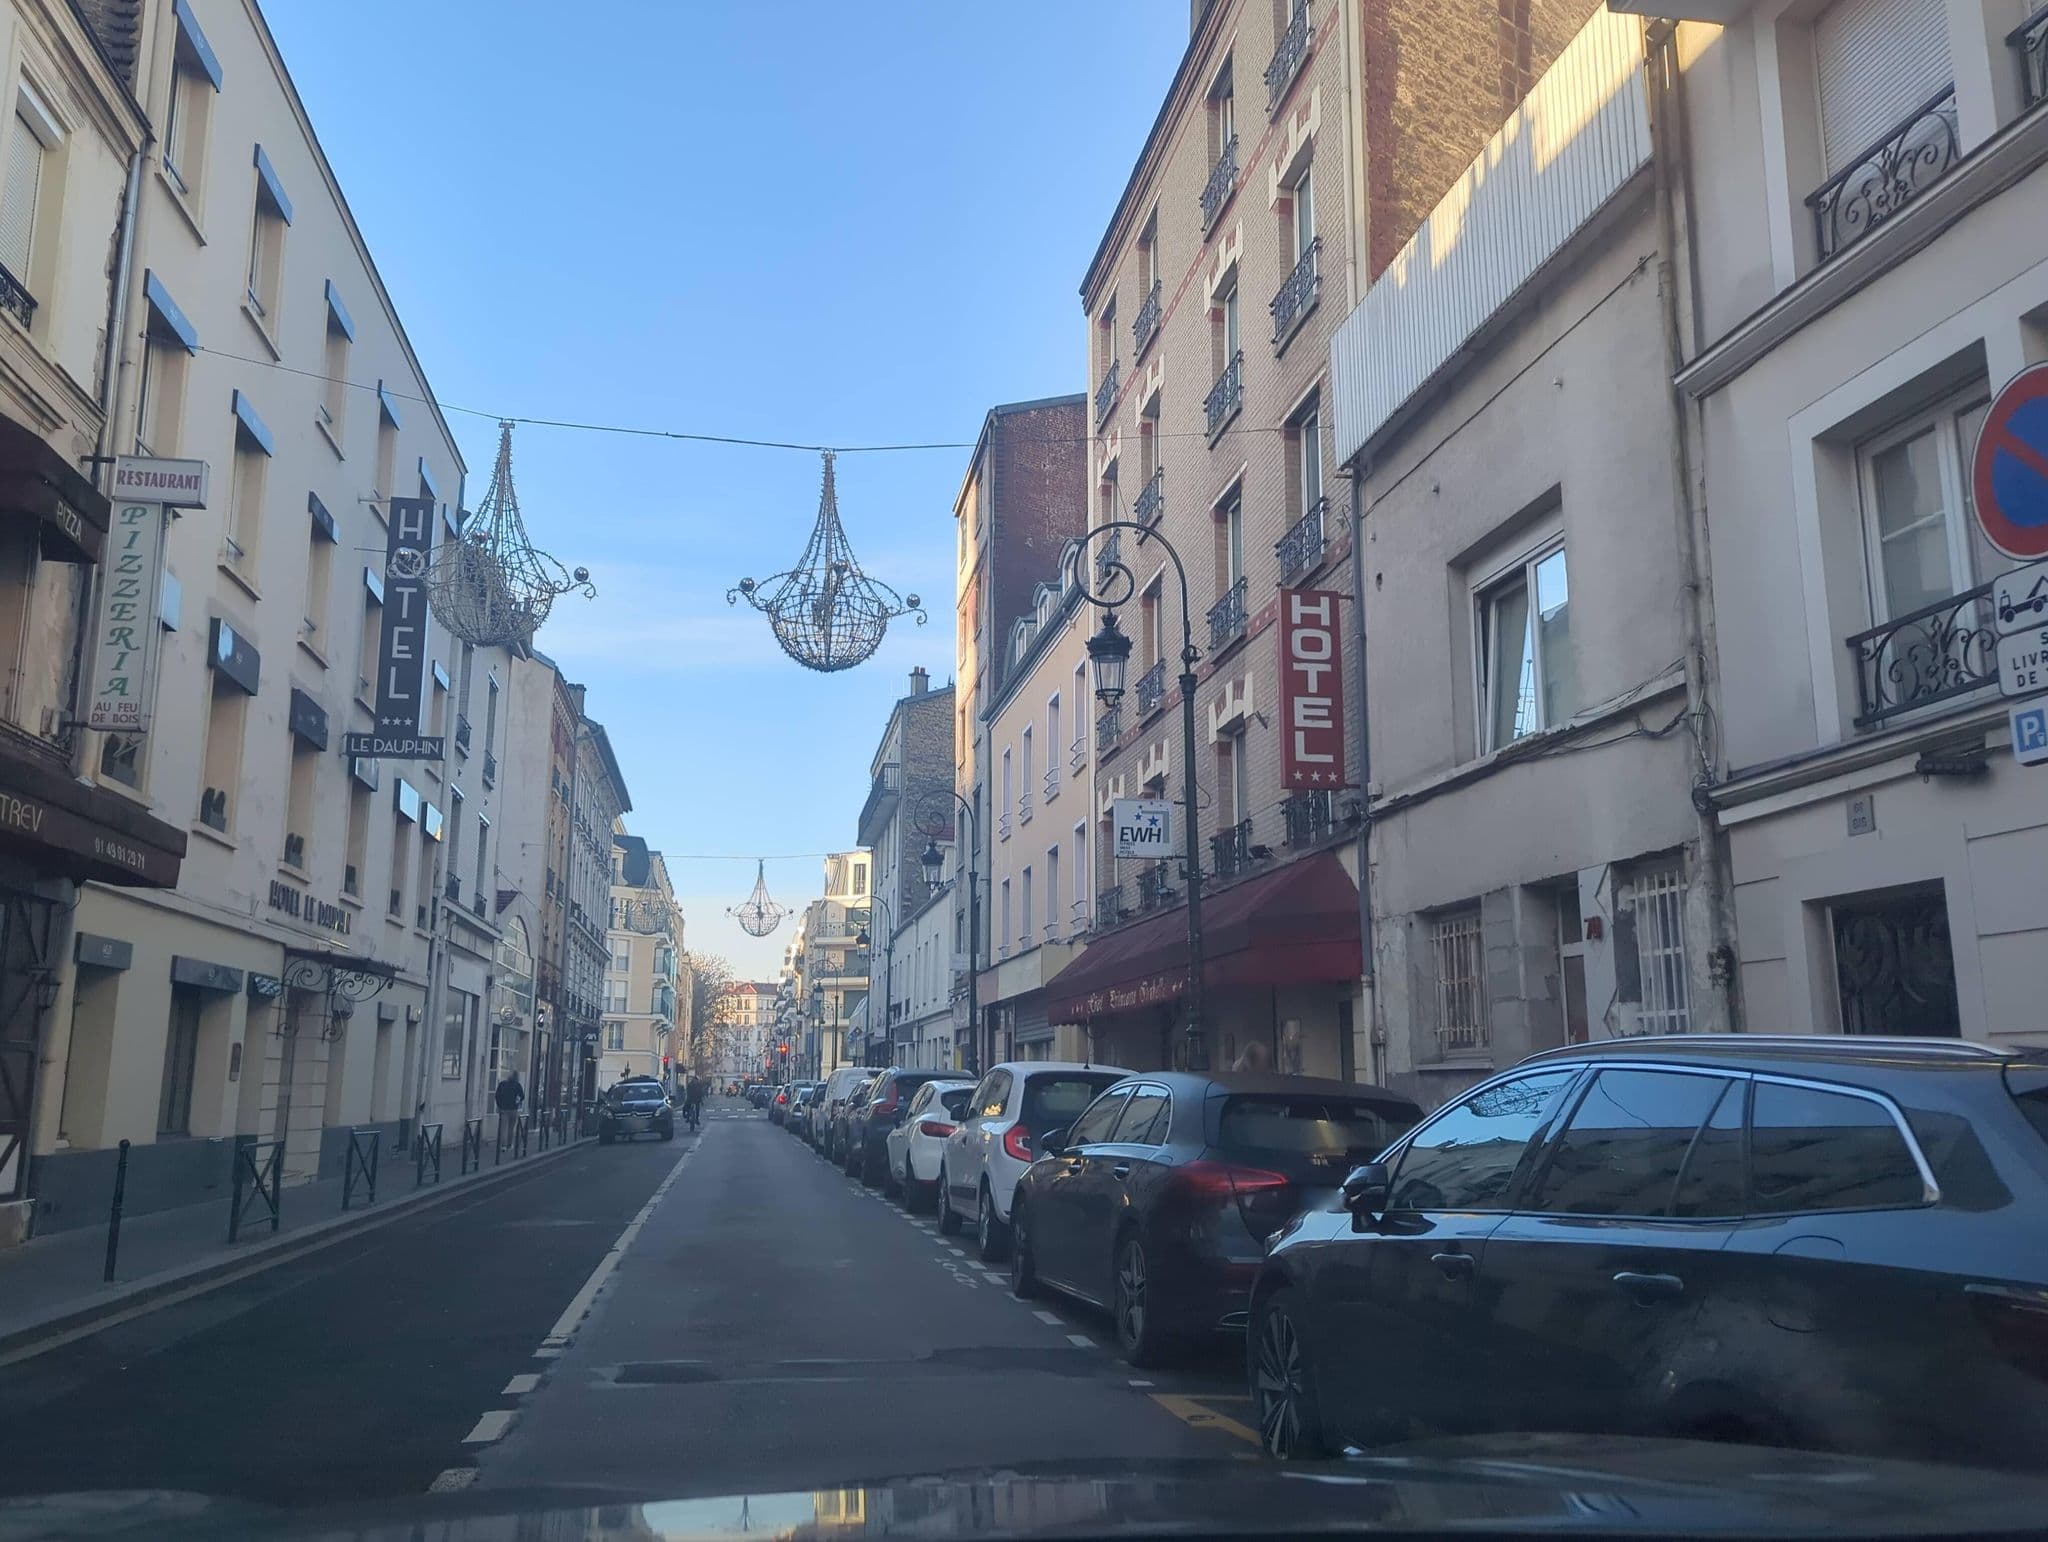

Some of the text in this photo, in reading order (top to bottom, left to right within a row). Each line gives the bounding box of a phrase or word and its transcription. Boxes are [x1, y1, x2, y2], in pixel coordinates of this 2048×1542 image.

[117, 469, 200, 490] RESTAURANT
[56, 500, 82, 543] PIZZA
[101, 506, 148, 697] PIZZERIA
[1291, 594, 1334, 763] HOTEL
[2017, 671, 2038, 687] DE
[94, 702, 138, 713] AU FEU
[92, 713, 139, 724] DE BOIS
[351, 737, 439, 755] LE DAUPHIN
[1120, 826, 1161, 843] EWH
